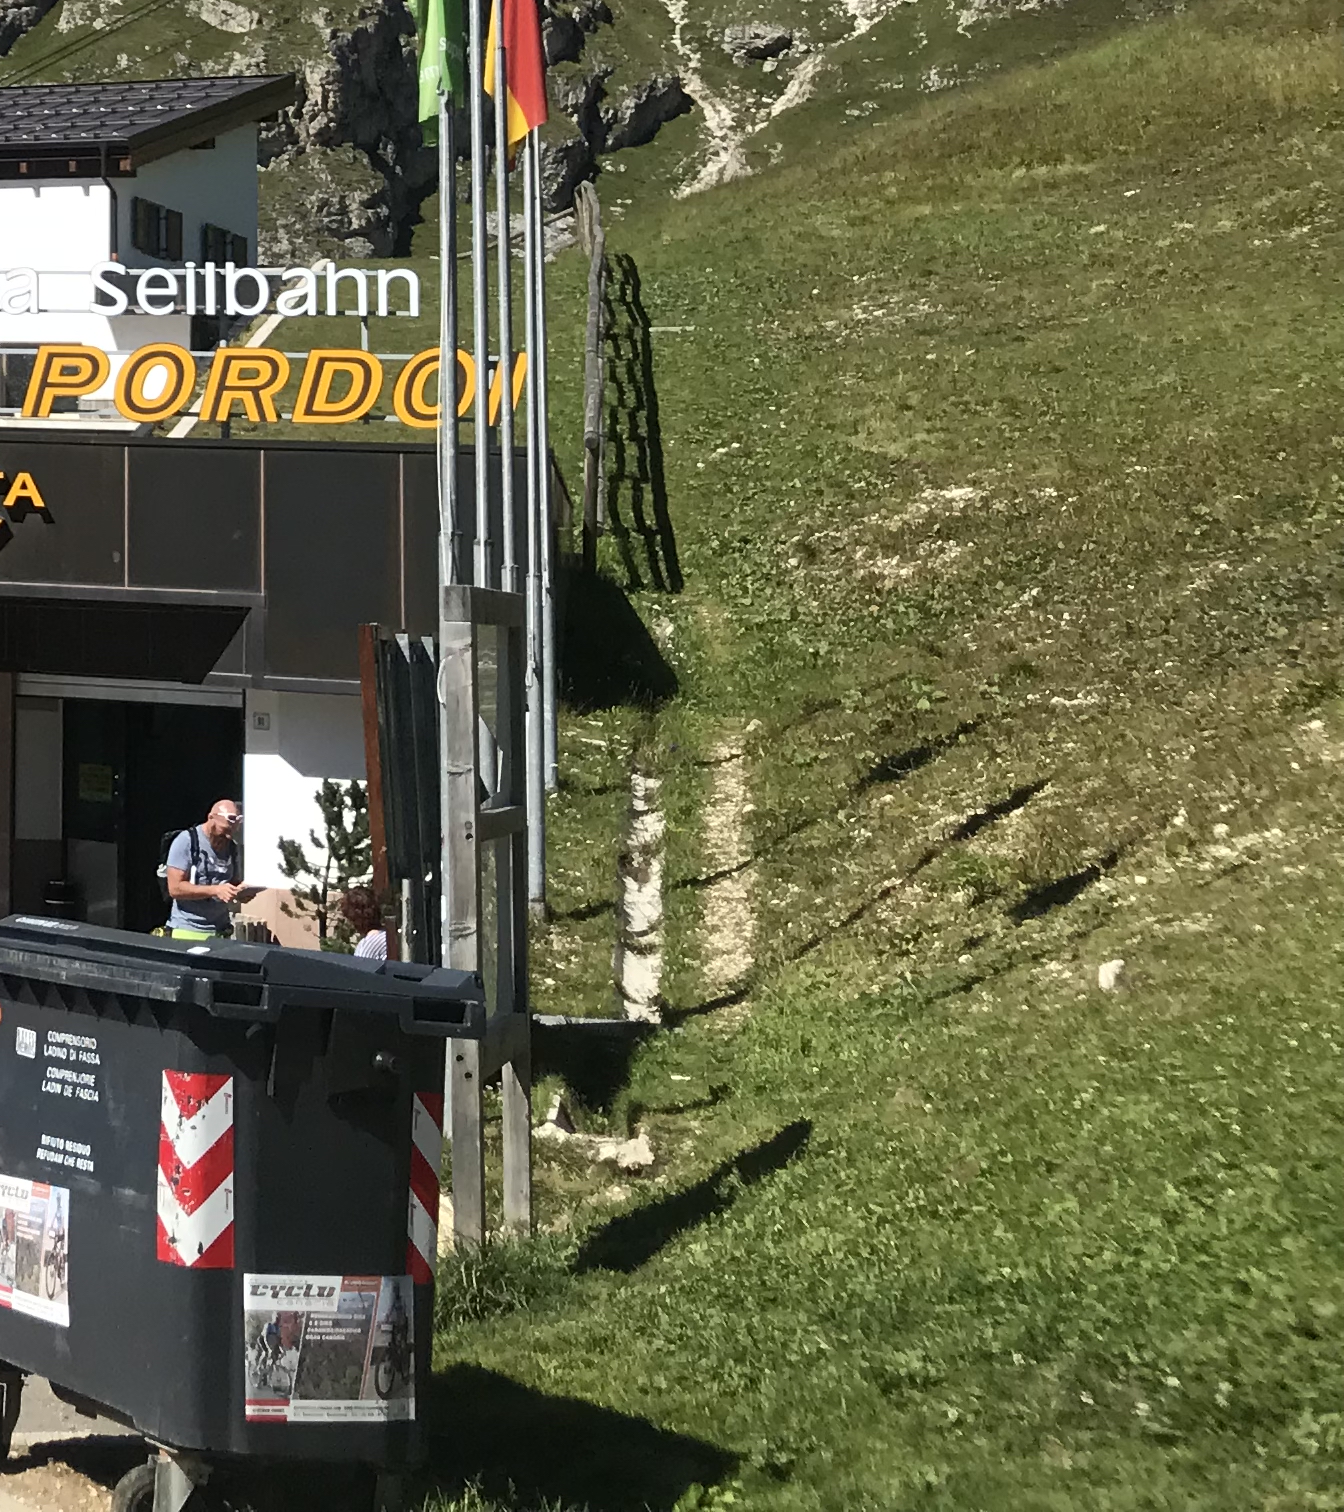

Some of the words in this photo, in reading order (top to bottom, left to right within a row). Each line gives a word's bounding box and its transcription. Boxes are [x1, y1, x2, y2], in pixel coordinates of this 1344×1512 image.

[89, 260, 420, 318] Seilbahn
[43, 1044, 67, 1061] LADINO
[69, 1049, 77, 1061] DI
[78, 1050, 101, 1065] FASSA
[41, 1080, 62, 1095] LADIN
[63, 1085, 73, 1098] DE
[75, 1087, 99, 1102] FASCIA
[64, 1155, 76, 1167] CHE
